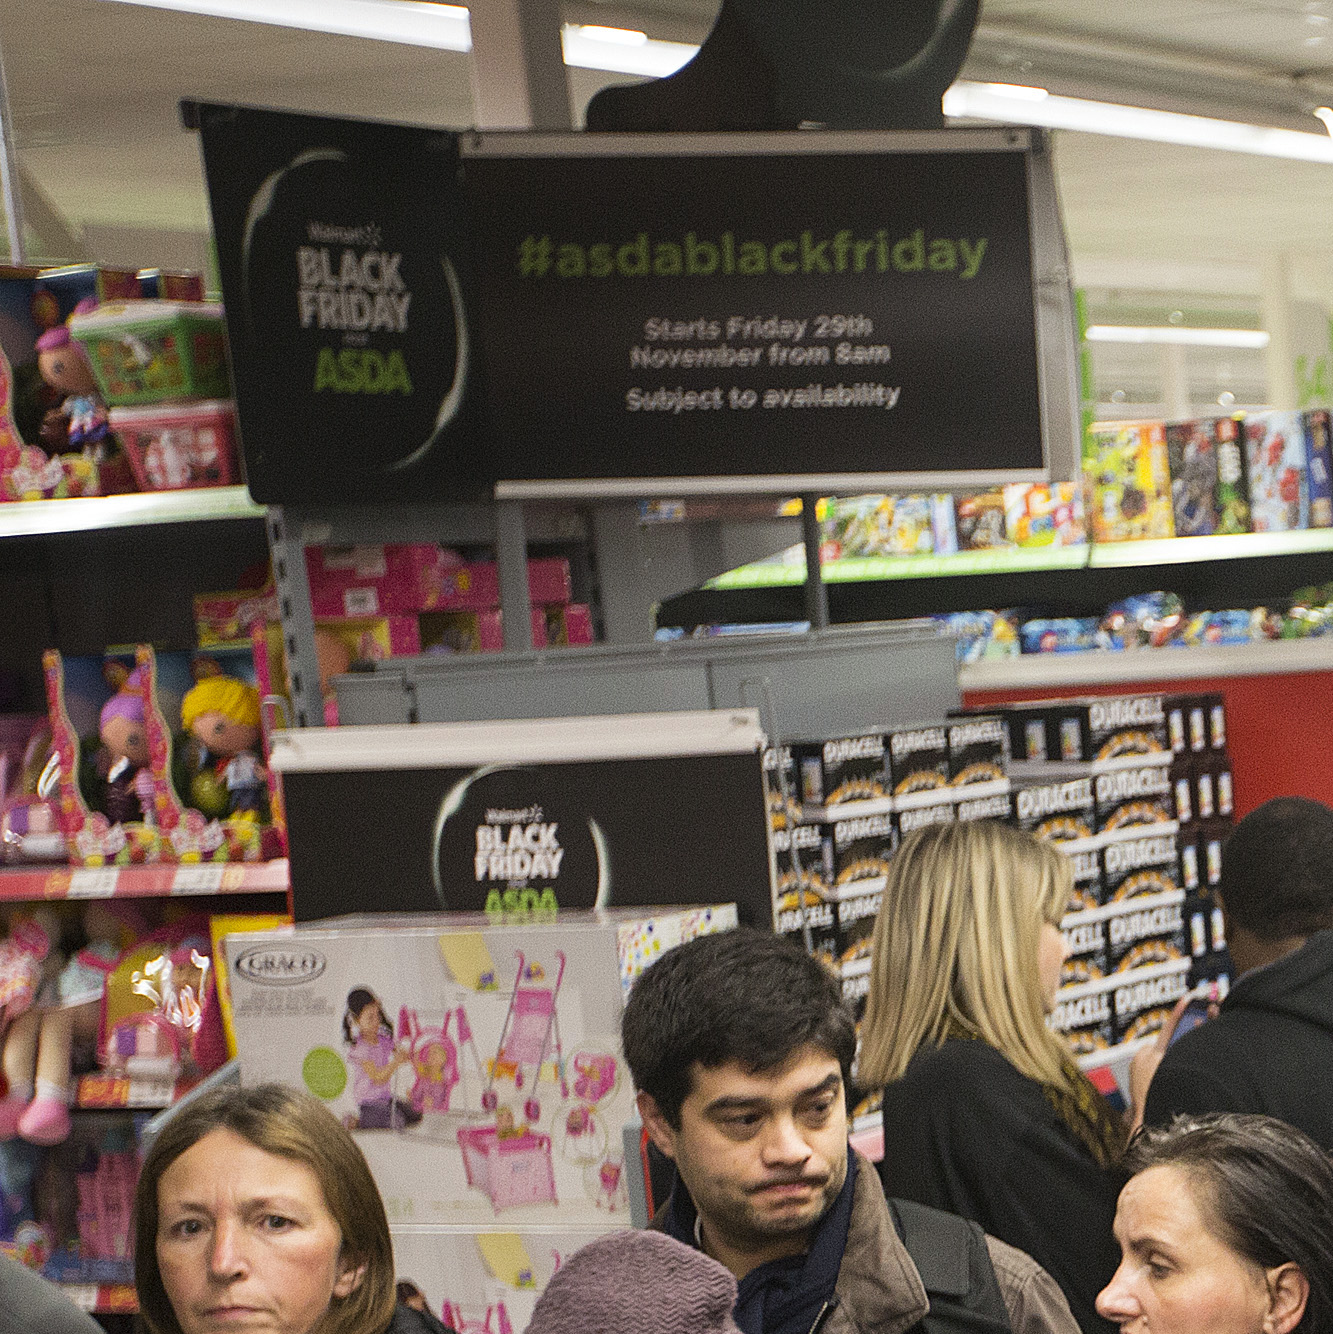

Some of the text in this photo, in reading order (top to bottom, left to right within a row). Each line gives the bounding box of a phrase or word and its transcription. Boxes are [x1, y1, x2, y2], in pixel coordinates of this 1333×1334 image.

[297, 246, 407, 292] BLACK
[517, 230, 988, 279] #asdablackfriday
[298, 287, 412, 333] FRIDAY
[644, 313, 873, 342] Starts Friday 29th
[315, 348, 413, 395] ASDA
[629, 344, 763, 369] November
[769, 343, 830, 367] from
[626, 381, 901, 414] Subject to availability
[1089, 697, 1164, 731] DURACELL
[823, 735, 884, 764] DURACELL
[890, 727, 948, 755] DURACELL
[949, 720, 1002, 747] DURACELL
[1017, 778, 1094, 819] DURACELL
[1096, 767, 1170, 801] DURACELL
[959, 795, 1011, 823] DURACELL
[476, 822, 560, 853] BLACK
[835, 813, 891, 844] DURACELL
[474, 848, 564, 881] FRIDAY
[1105, 837, 1178, 873] DURACELL
[485, 887, 558, 926] ASDA
[1109, 906, 1183, 944] DURACELL
[1115, 973, 1187, 1016] DURACELL
